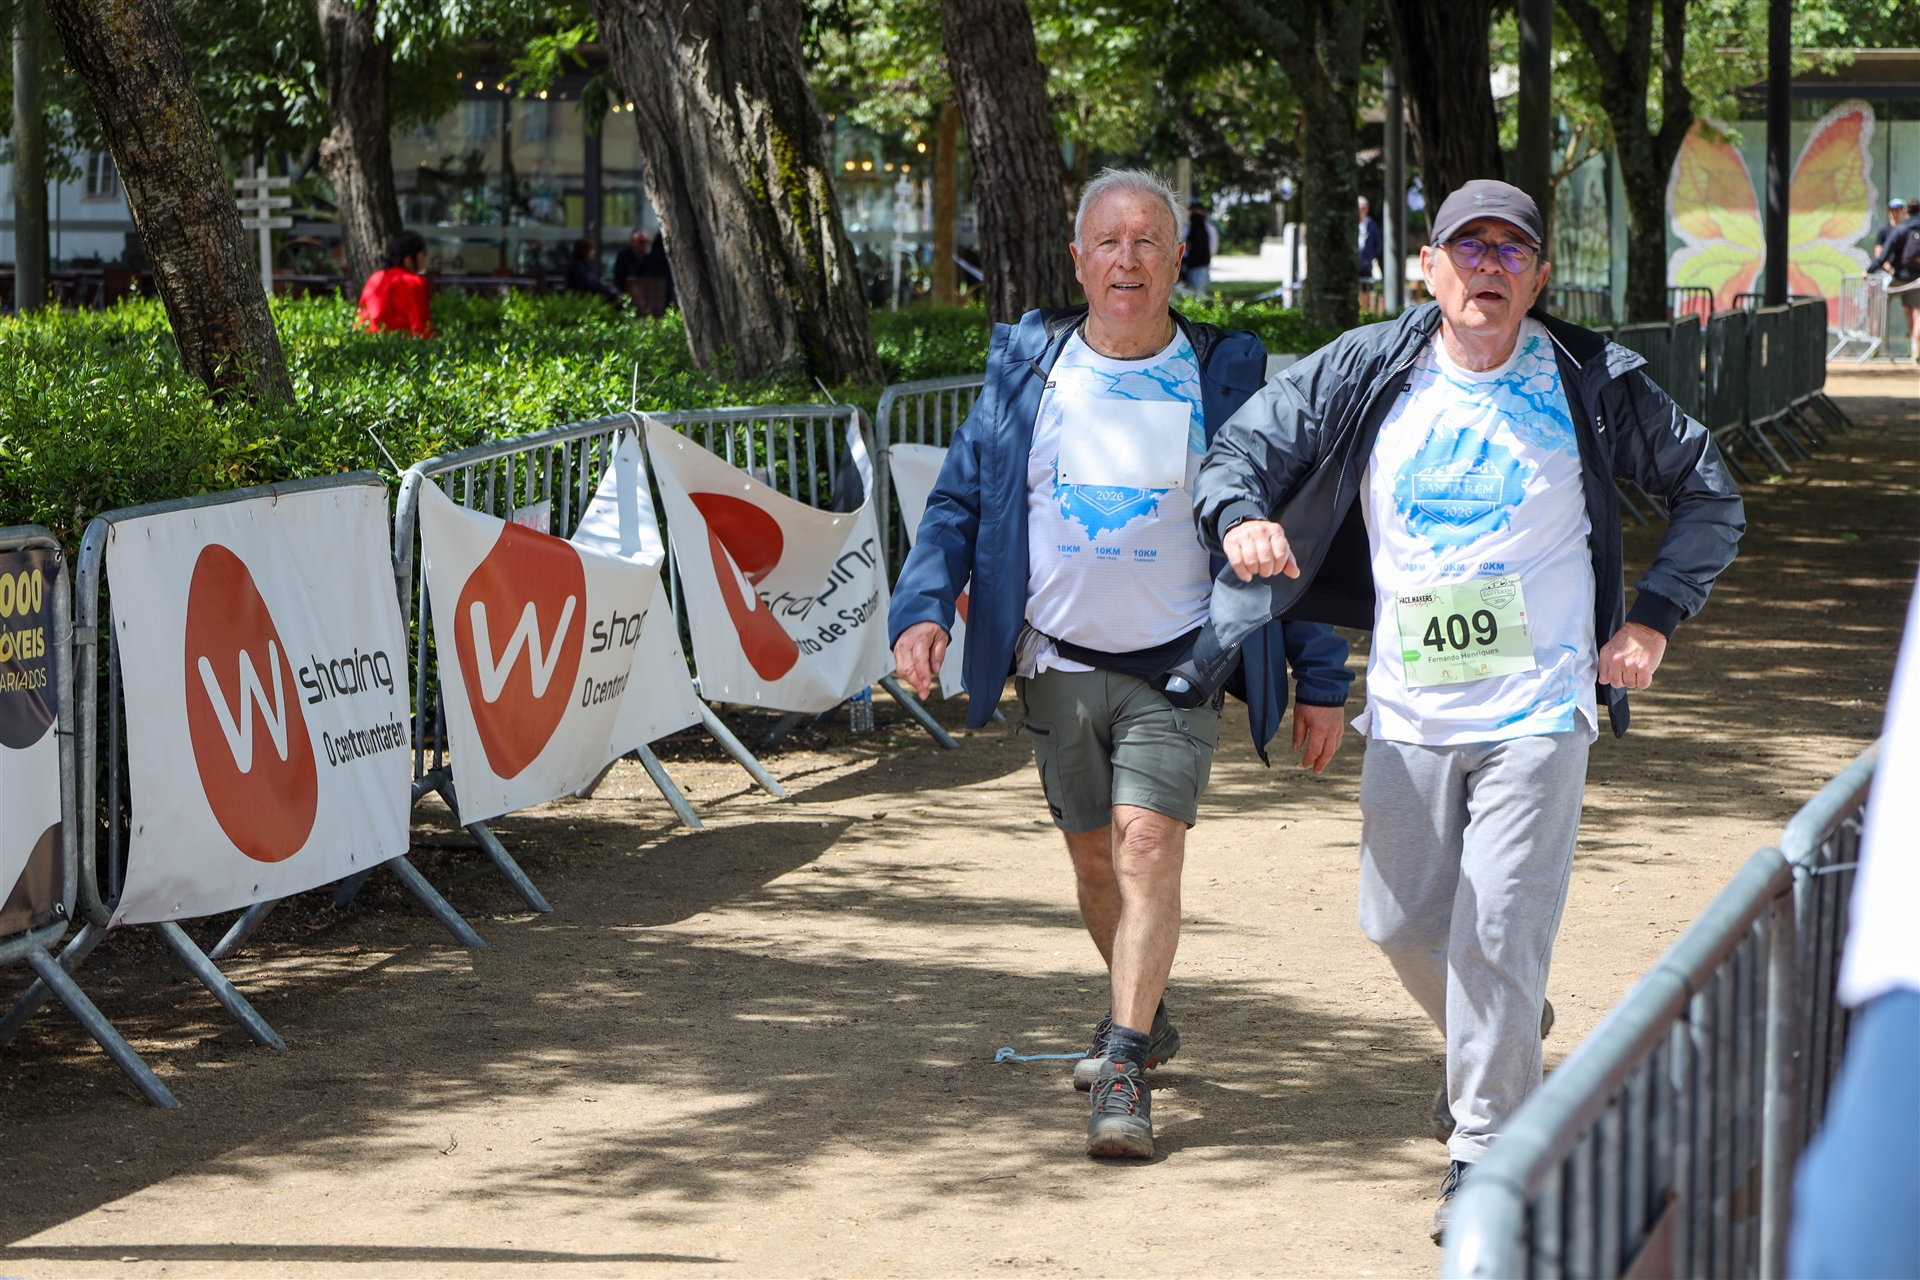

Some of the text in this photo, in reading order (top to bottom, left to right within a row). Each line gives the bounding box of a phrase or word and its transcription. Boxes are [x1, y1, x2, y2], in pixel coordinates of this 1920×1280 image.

[1418, 482, 1494, 494] SANTARÉM
[1096, 491, 1124, 501] 2026
[1442, 506, 1473, 518] 2026
[1057, 545, 1080, 553] 18KM
[1095, 547, 1120, 555] 10KM
[1134, 549, 1157, 557] 10KM
[1479, 562, 1504, 571] 10KM
[817, 623, 847, 644] de
[1423, 609, 1498, 652] 409
[1428, 654, 1460, 663] Fernando
[1461, 648, 1499, 660] Henriques
[1210, 660, 1227, 682] KIPRUN
